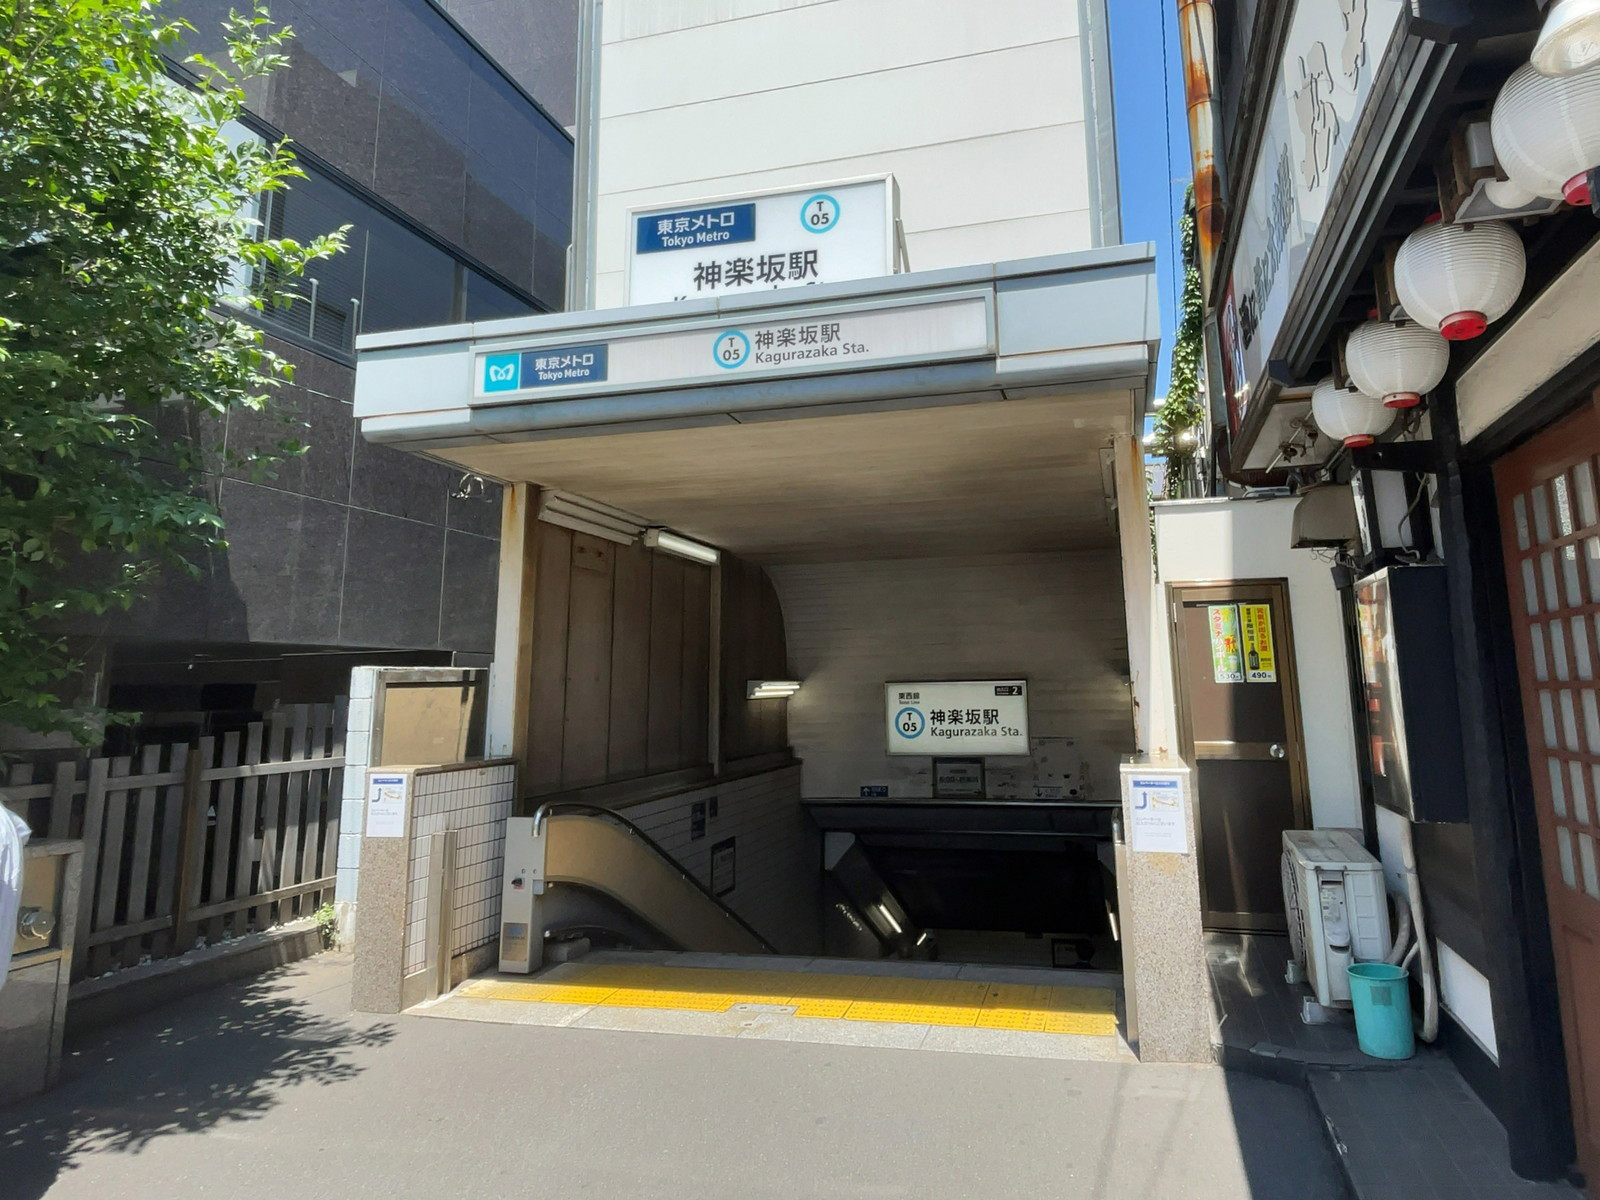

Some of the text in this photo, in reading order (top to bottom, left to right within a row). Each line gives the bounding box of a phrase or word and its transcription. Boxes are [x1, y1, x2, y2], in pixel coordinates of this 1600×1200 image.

[816, 201, 824, 211] T
[657, 212, 735, 235] 東京メトロ
[811, 213, 829, 225] 05
[662, 230, 730, 248] Tokyo Metro
[693, 250, 819, 291] 神楽坂駅
[728, 337, 735, 347] T
[755, 323, 841, 350] 神楽坂駅
[723, 349, 740, 361] 05
[756, 342, 869, 365] Kagurazaka Sta.
[535, 353, 594, 371] 東京メトロ
[538, 368, 590, 381] Tokyo Metro
[1012, 686, 1018, 695] 2
[907, 712, 913, 721] T
[930, 709, 999, 725] 神楽坂駅
[902, 722, 917, 732] 05
[931, 726, 1022, 739] Kagurazaka Sta.
